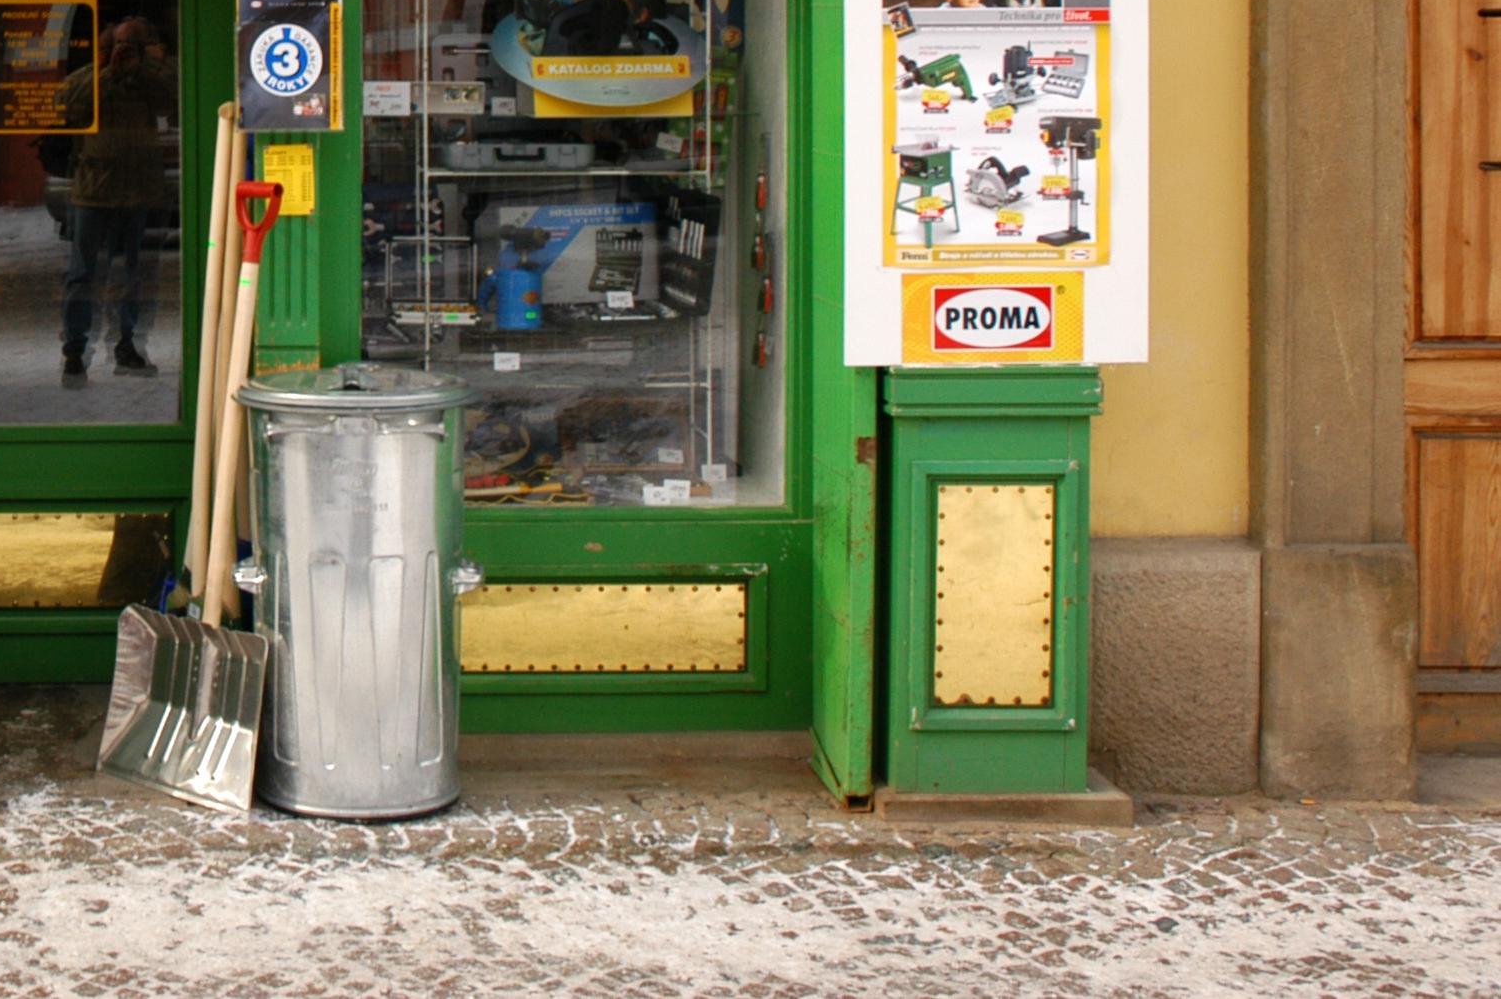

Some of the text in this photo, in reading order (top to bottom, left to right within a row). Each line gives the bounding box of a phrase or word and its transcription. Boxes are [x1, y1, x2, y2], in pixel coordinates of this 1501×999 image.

[998, 10, 1042, 21] Technika
[1044, 13, 1062, 22] pro
[272, 42, 301, 77] 3
[548, 61, 674, 75] KATALOG ZDARMA
[266, 74, 308, 92] ROKY
[944, 306, 1041, 330] PROMA
